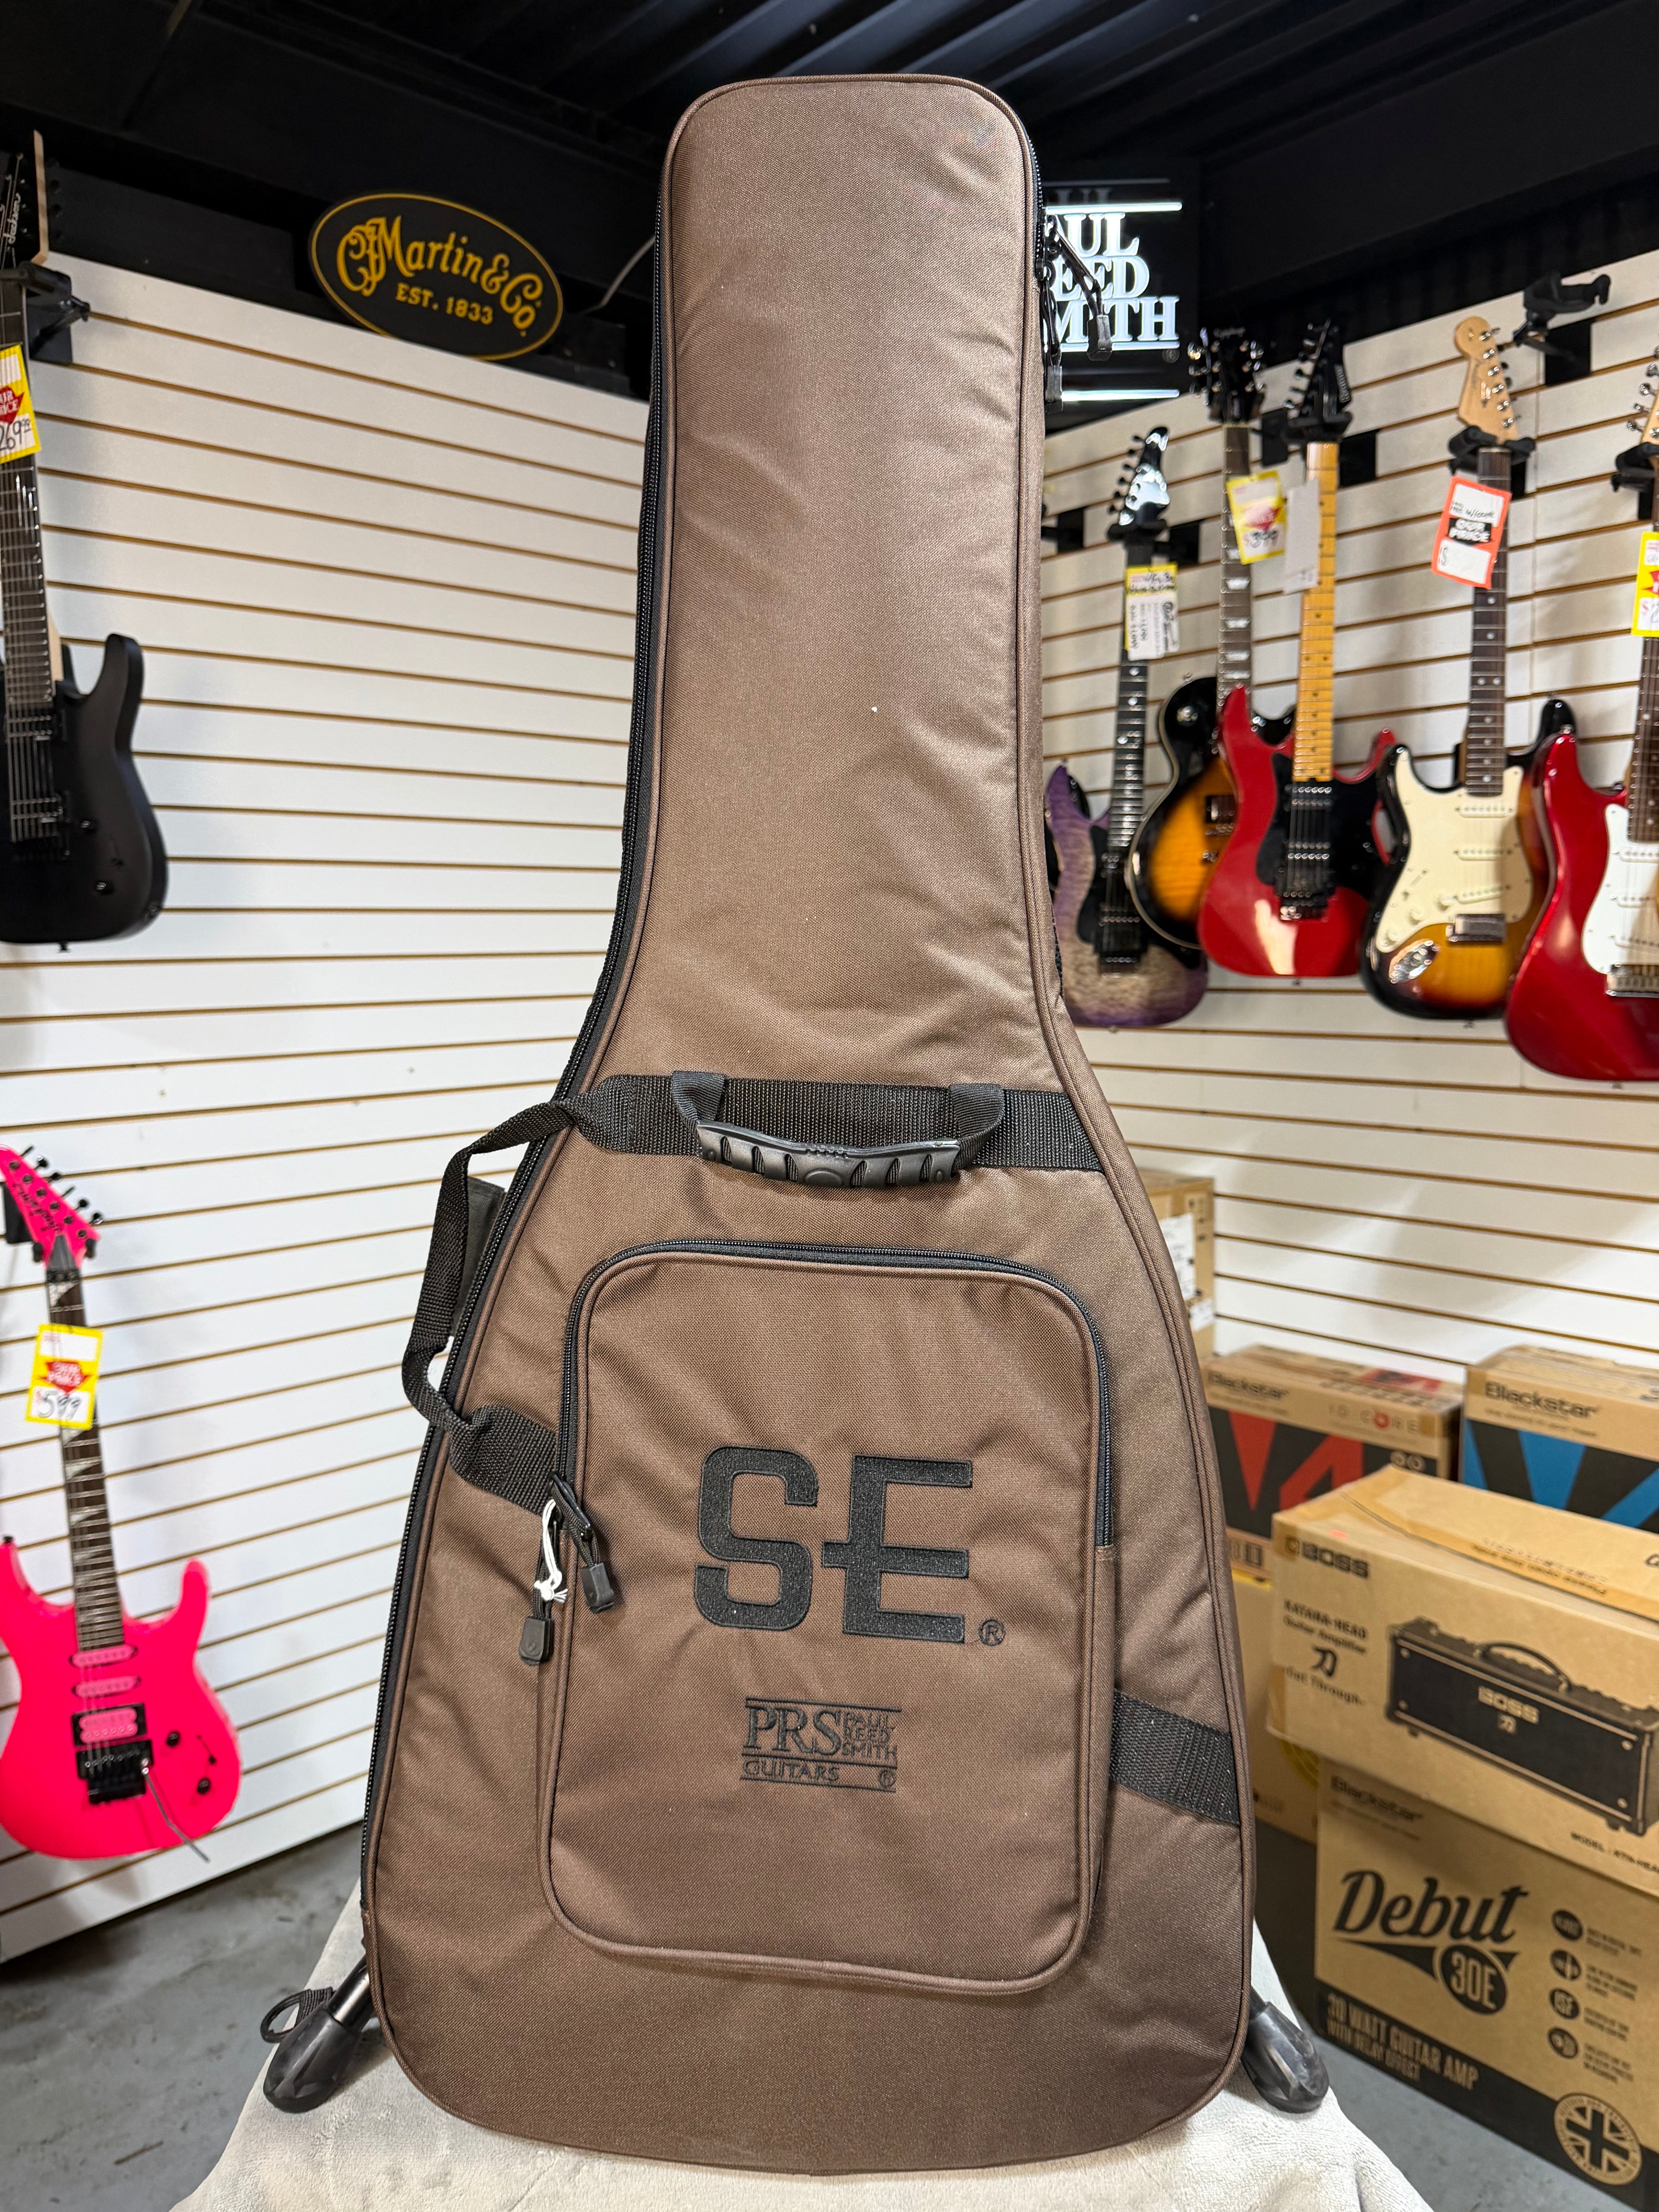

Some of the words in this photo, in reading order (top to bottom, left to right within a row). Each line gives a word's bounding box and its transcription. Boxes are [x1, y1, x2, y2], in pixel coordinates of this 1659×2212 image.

[1046, 254, 1150, 301] EED
[396, 283, 438, 309] EST.
[447, 297, 493, 325] 1833
[1448, 527, 1491, 543] PRICE
[1484, 1381, 1599, 1418] Blackstar
[695, 1444, 973, 1644] SE
[1301, 1542, 1370, 1580] BOSS
[1318, 1629, 1367, 1654] Amplifier
[843, 1712, 896, 1731] PAUL
[1478, 1685, 1540, 1726] BOSS
[744, 1705, 841, 1756] PRS
[843, 1727, 892, 1743] REED
[743, 1760, 840, 1782] GUITARS
[842, 1741, 898, 1762] SMITH
[1331, 1775, 1424, 1822] Blackstar
[1334, 1870, 1530, 1944] Debut
[1451, 1951, 1498, 2010] 30E
[1328, 1992, 1347, 2024] 30
[1348, 2001, 1387, 2048] WATT
[1389, 2025, 1442, 2074] GUITAR
[1443, 2054, 1479, 2091] AMP
